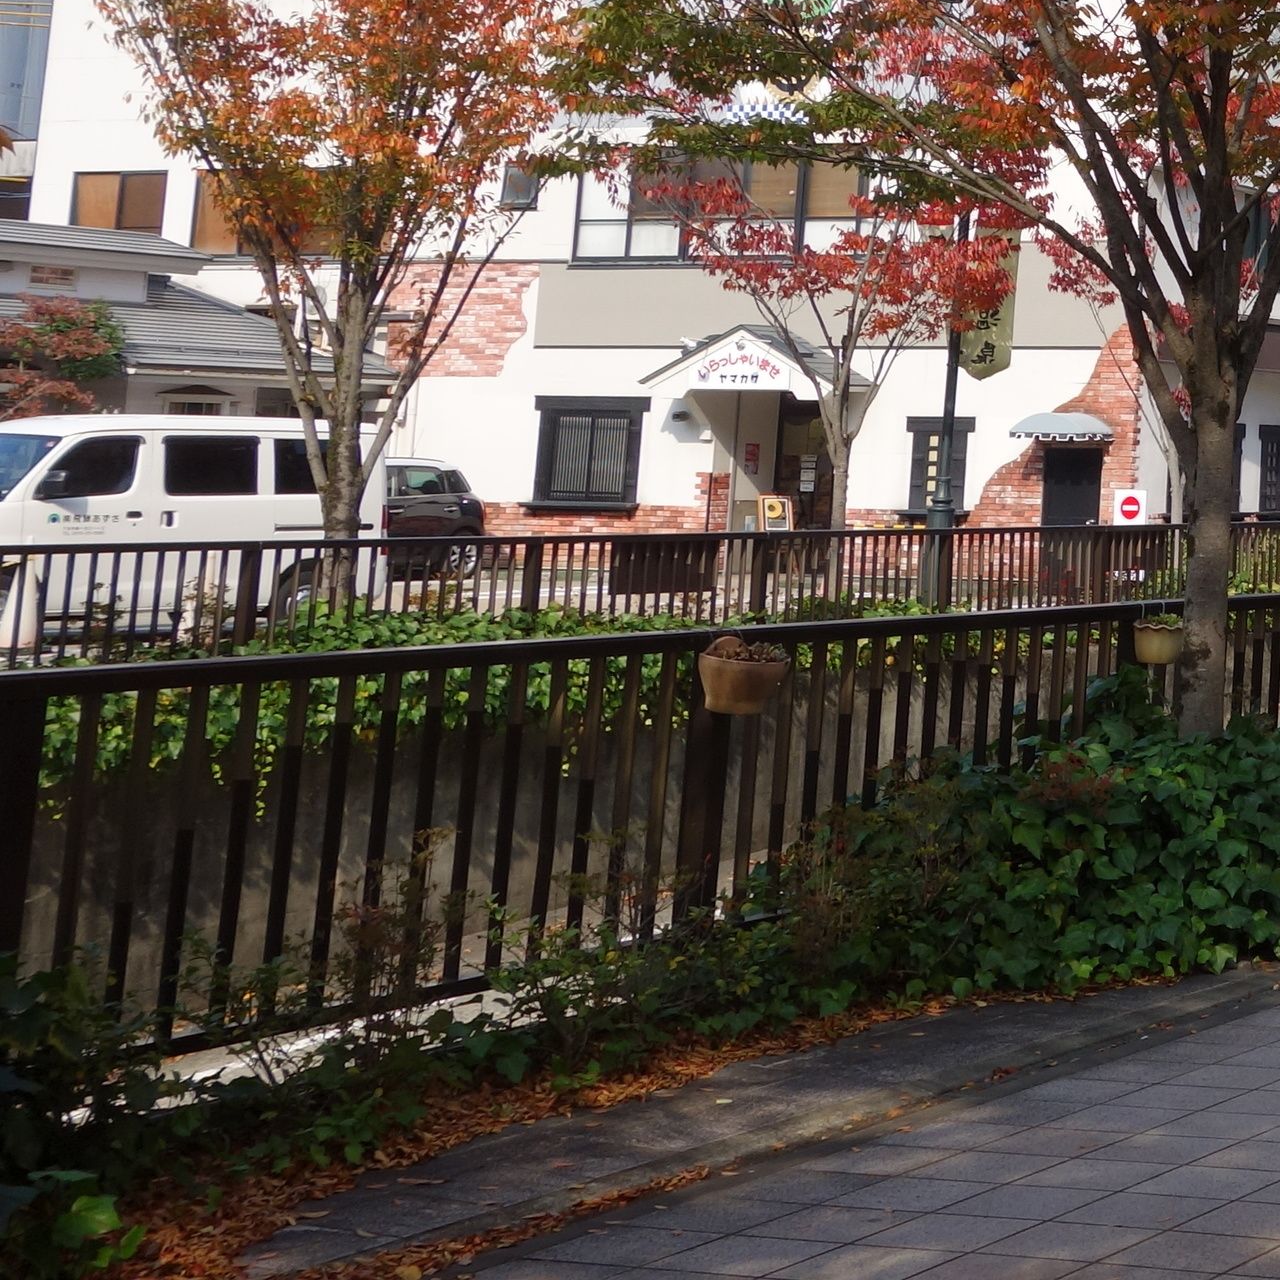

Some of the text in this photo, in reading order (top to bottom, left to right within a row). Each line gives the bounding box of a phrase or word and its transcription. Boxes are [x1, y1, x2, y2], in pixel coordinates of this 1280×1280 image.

[698, 353, 780, 380] いらっしゃいませ
